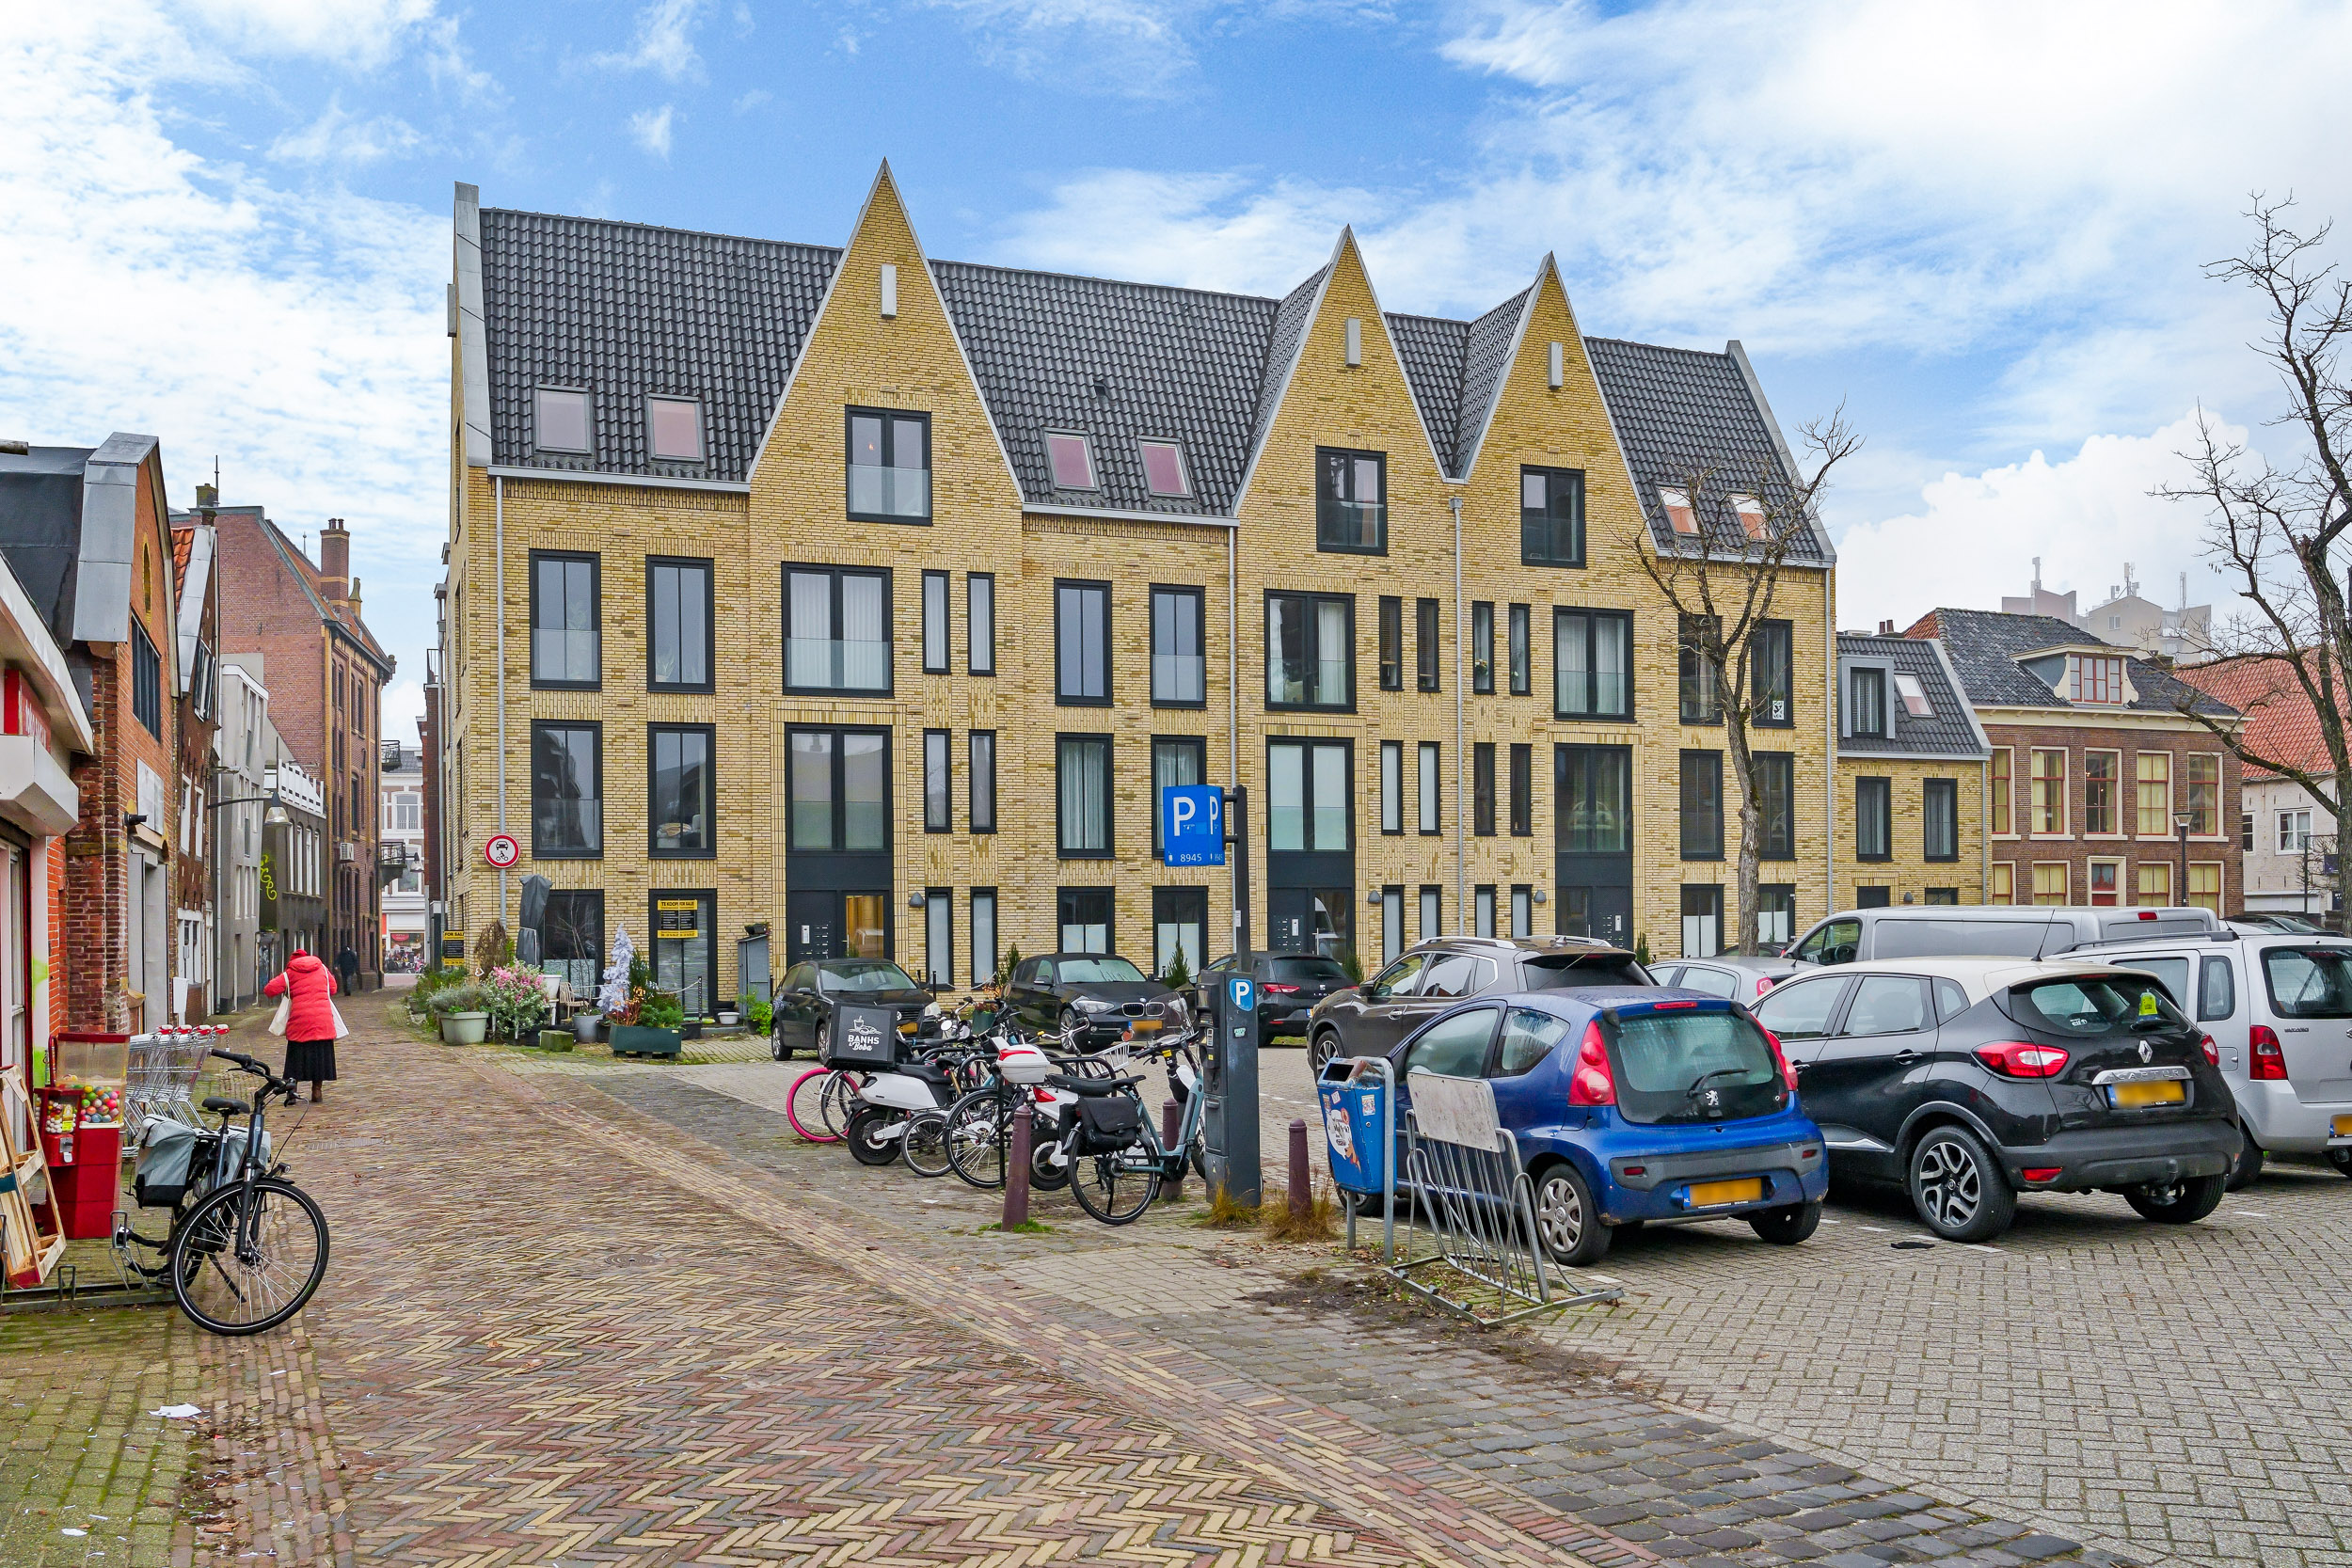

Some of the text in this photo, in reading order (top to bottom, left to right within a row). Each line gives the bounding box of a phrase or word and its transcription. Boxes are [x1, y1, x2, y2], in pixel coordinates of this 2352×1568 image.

[1173, 797, 1196, 836] P
[1210, 796, 1218, 835] P
[1180, 853, 1202, 863] 8945
[1235, 982, 1249, 1006] P
[848, 1035, 880, 1044] BANHS
[852, 1042, 873, 1052] Boba
